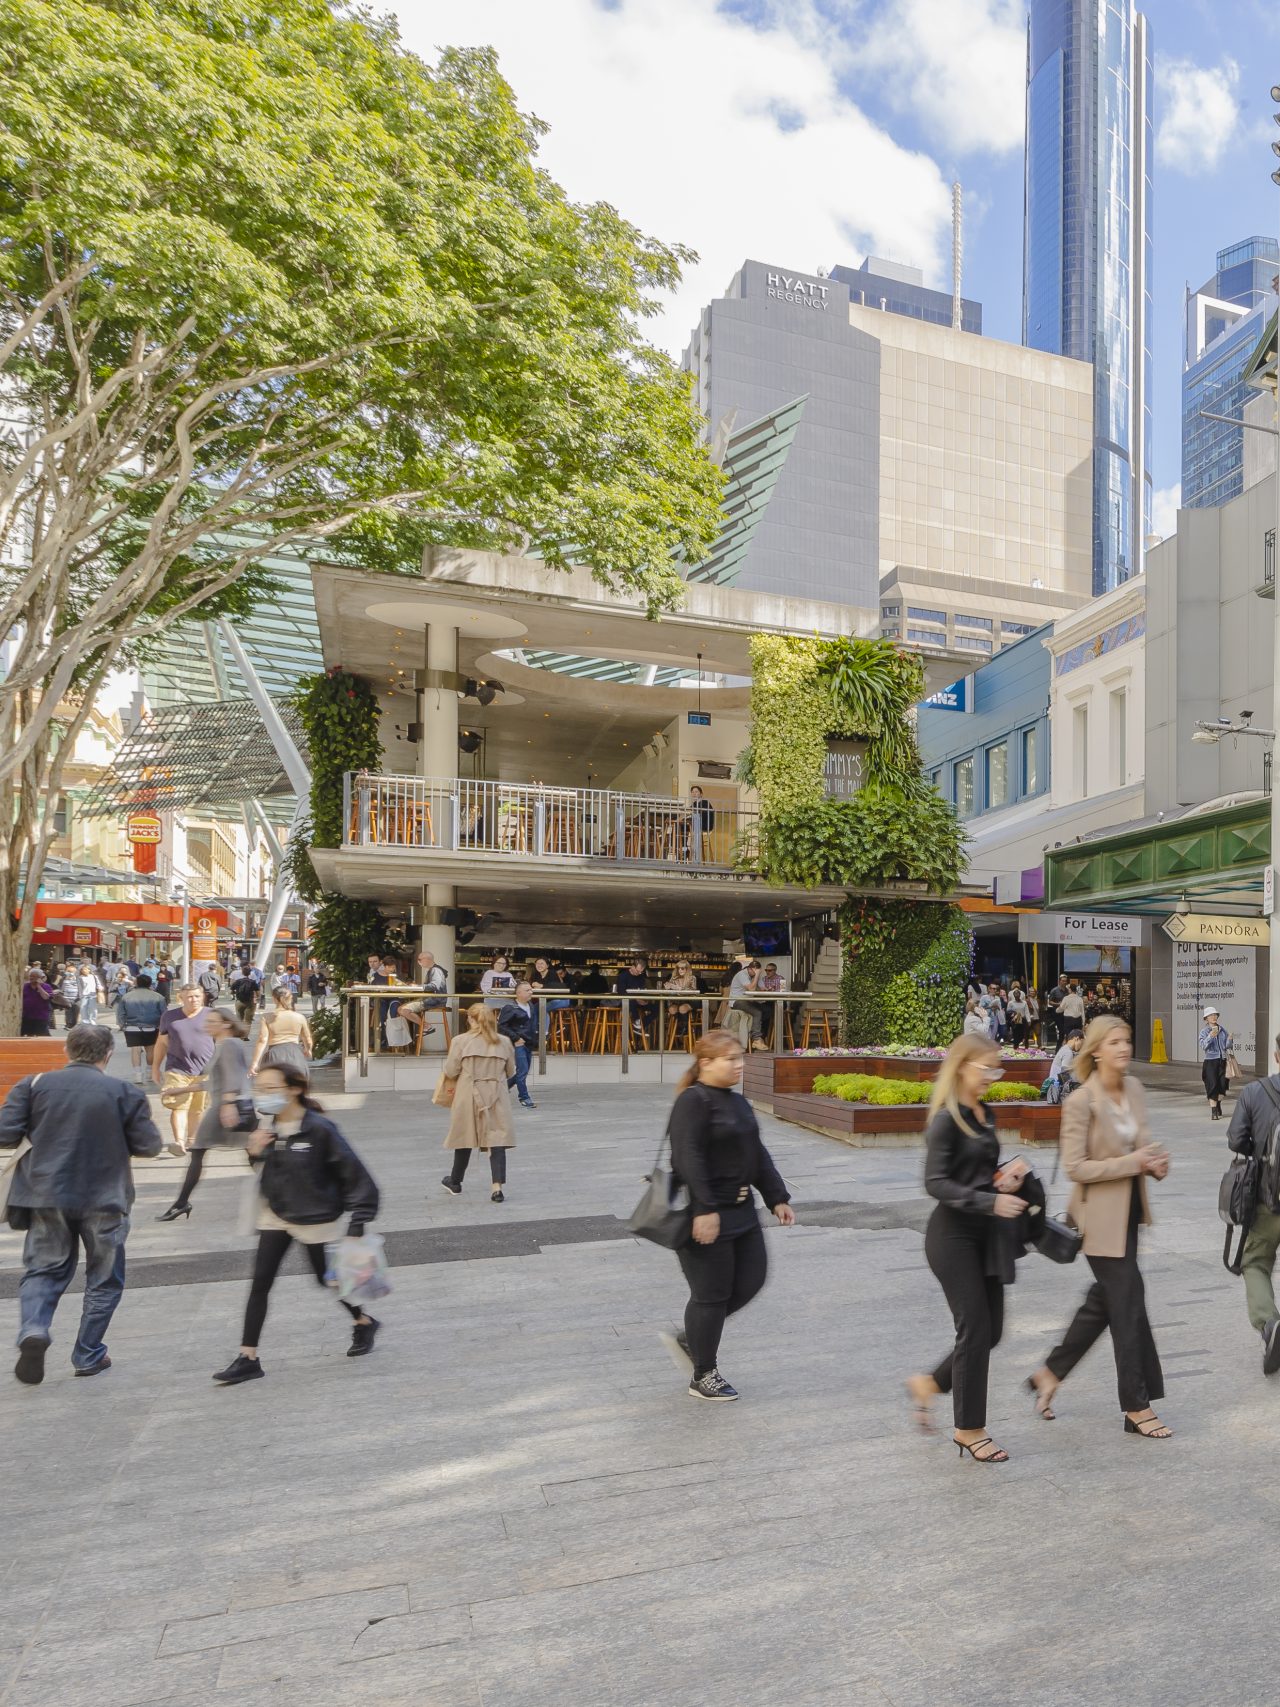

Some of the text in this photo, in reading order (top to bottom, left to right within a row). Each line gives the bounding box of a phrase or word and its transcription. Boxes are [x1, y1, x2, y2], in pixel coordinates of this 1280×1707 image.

[768, 272, 829, 299] HYATT
[768, 287, 829, 310] REGENCY
[826, 752, 862, 777] IMMY'S
[834, 778, 845, 793] THE
[1064, 917, 1129, 931] For Lease
[1200, 922, 1260, 937] PANDORA
[1225, 955, 1249, 967] opportunity
